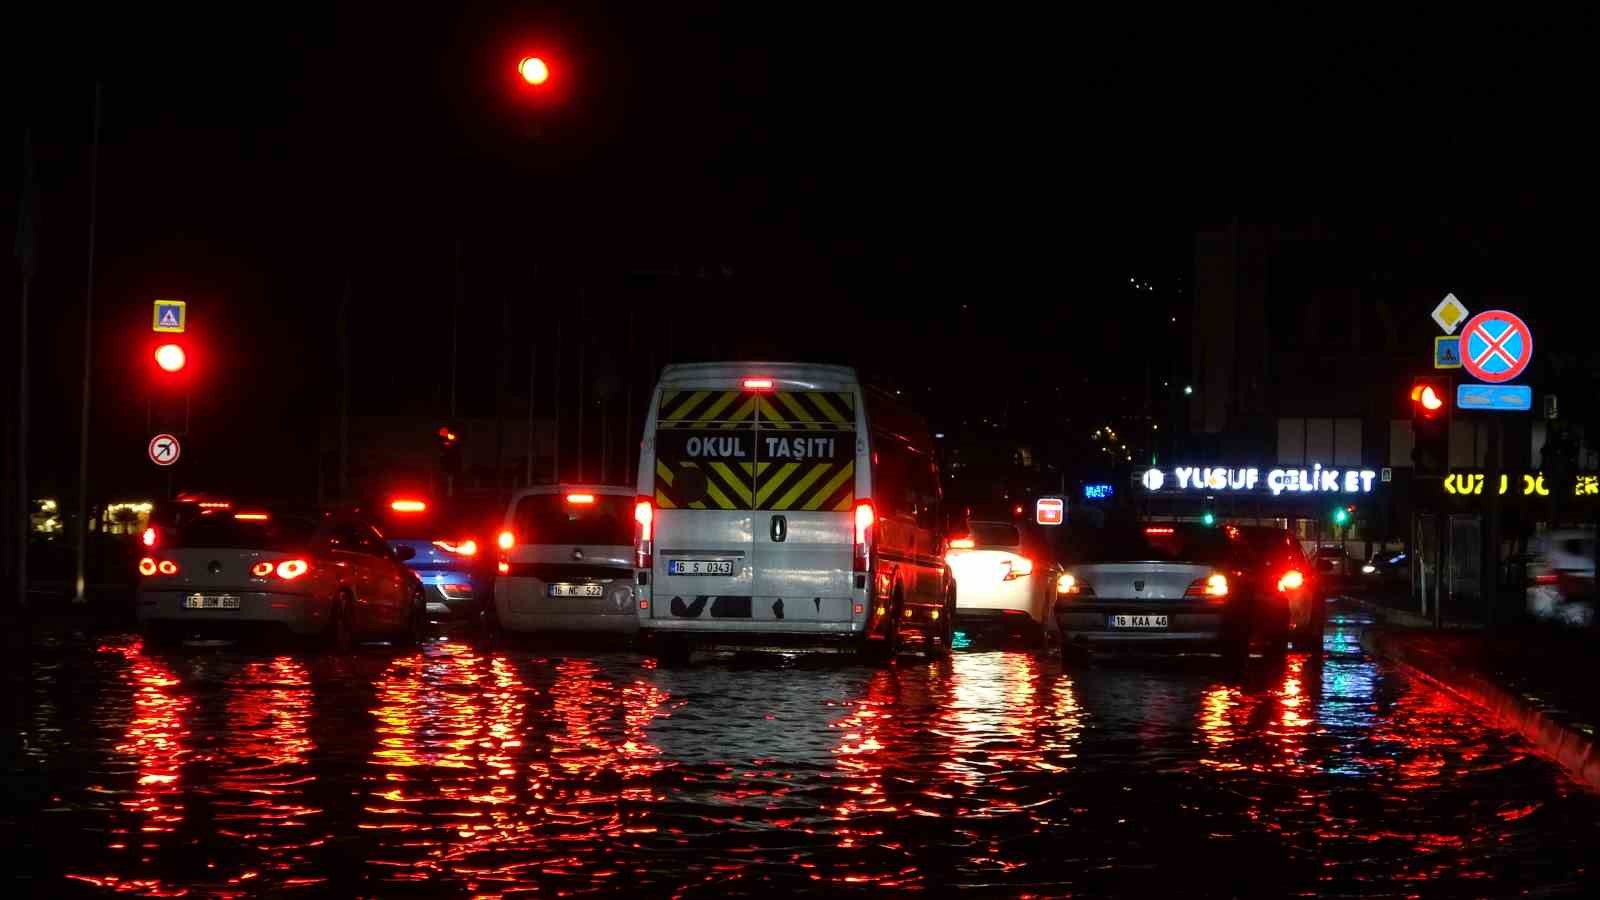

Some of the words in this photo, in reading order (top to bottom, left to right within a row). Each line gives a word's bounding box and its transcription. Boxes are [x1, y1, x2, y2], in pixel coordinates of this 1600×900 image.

[686, 437, 746, 457] OKUL
[766, 437, 835, 460] TAŞITI
[1175, 467, 1259, 490] YUSUF
[1268, 463, 1340, 495] ÇELİK
[1345, 470, 1376, 493] ET
[675, 562, 685, 572] 16
[693, 562, 699, 572] S
[706, 562, 730, 573] 0343
[1116, 616, 1126, 626] 16
[1131, 616, 1150, 626] KAA
[1155, 616, 1167, 626] 46
